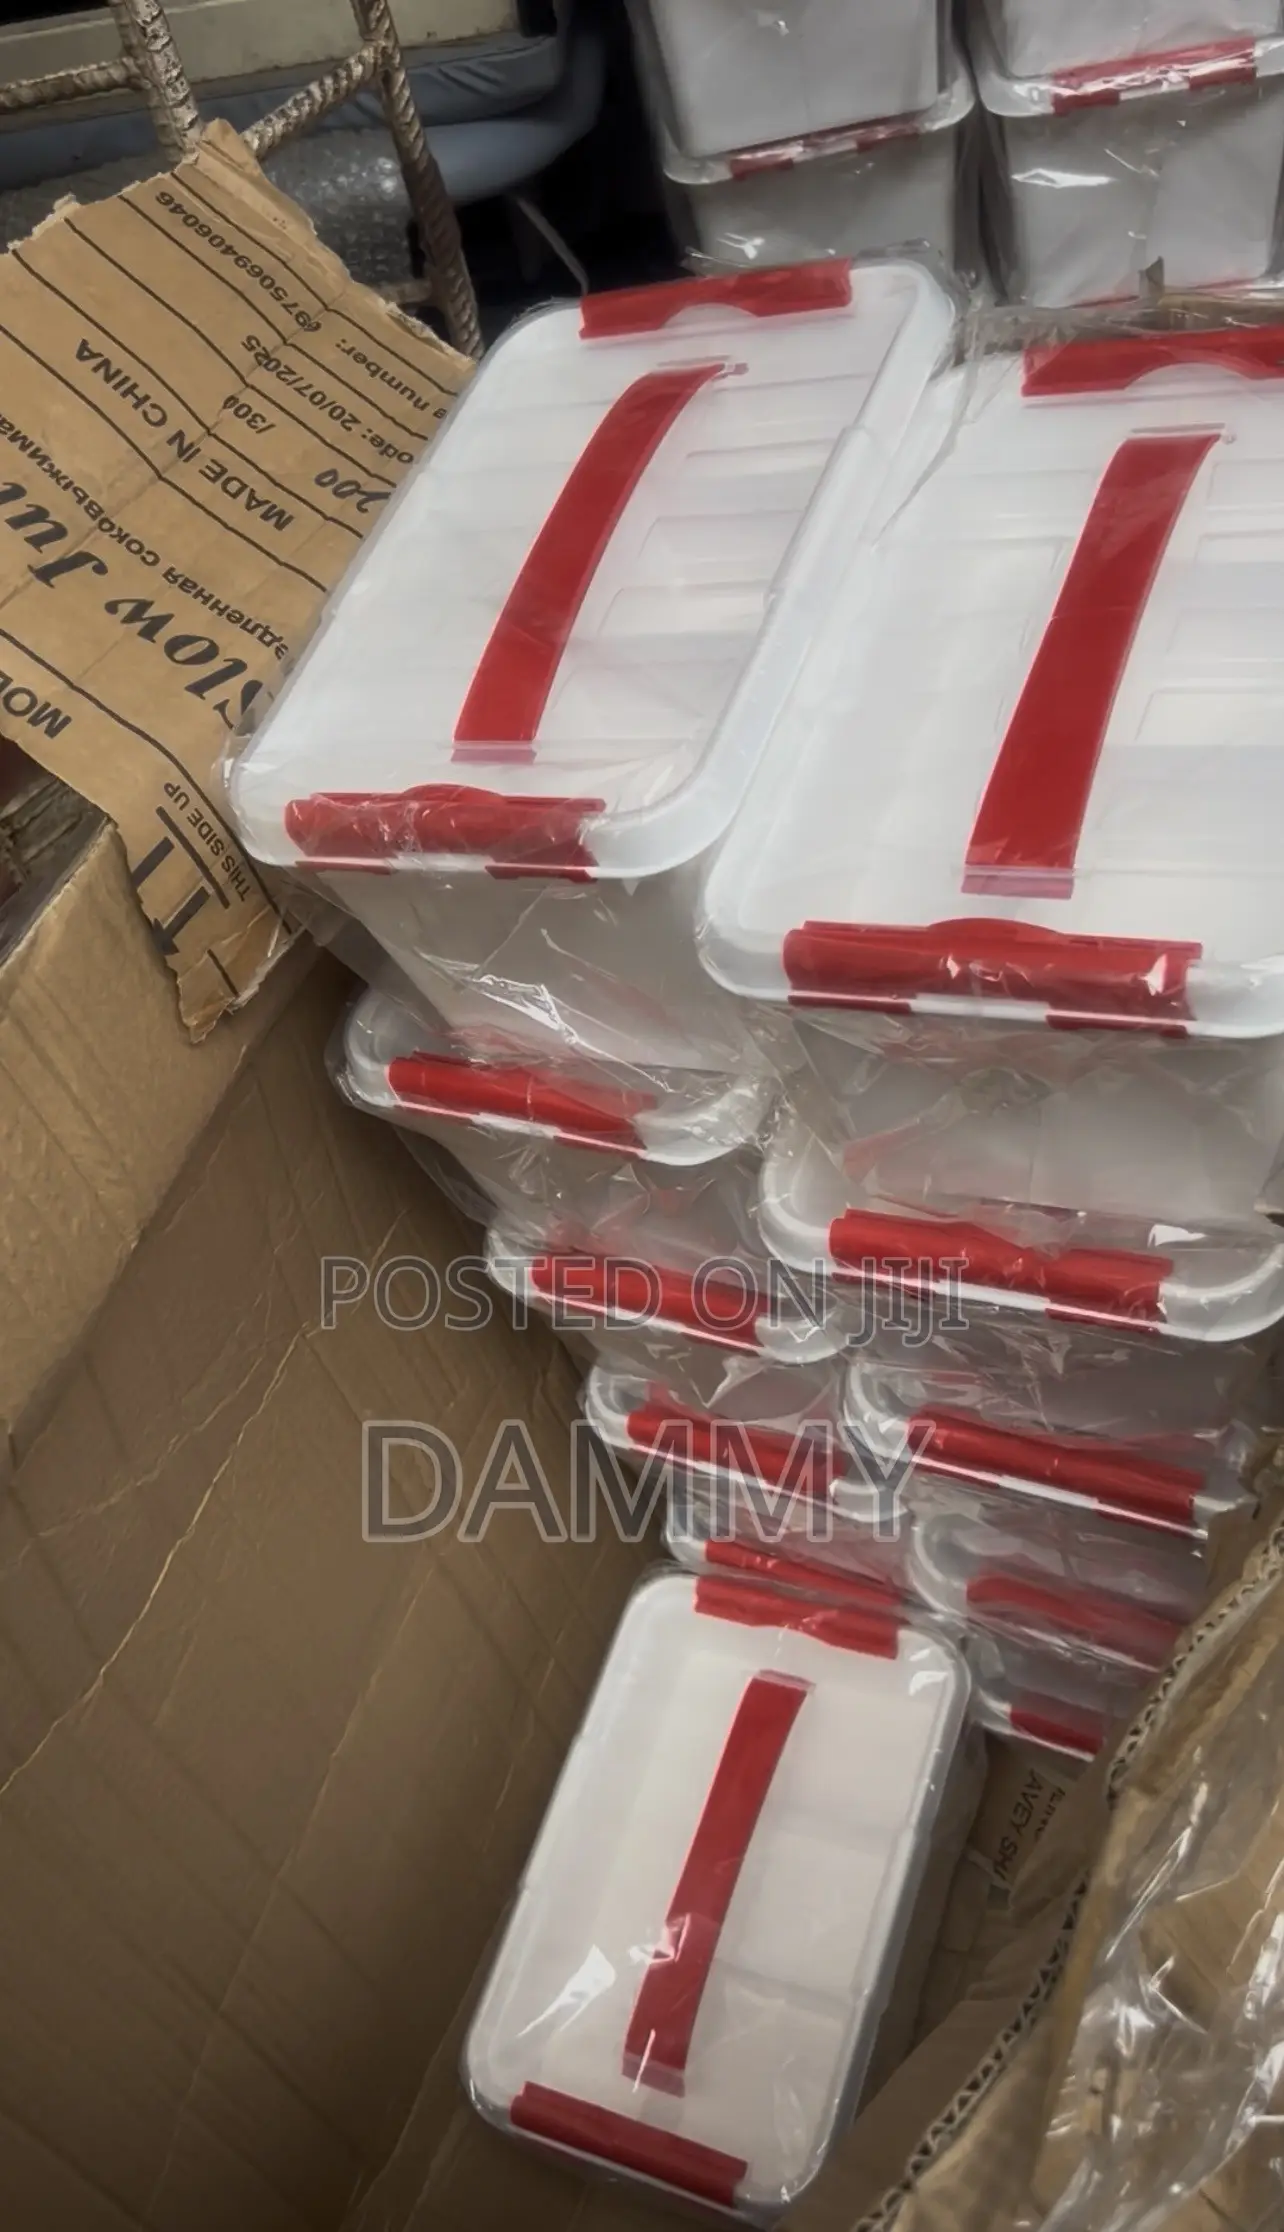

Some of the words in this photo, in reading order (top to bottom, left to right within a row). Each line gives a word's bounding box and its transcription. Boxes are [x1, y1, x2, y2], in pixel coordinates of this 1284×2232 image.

[75, 338, 168, 428] CHINA
[240, 334, 362, 432] 20/07/2025
[334, 338, 431, 412] number:
[166, 429, 202, 464] IN
[198, 457, 295, 532] MADE
[314, 468, 392, 514] 200
[163, 781, 191, 811] UP
[186, 807, 225, 857] SIDE
[221, 854, 251, 902] THIS
